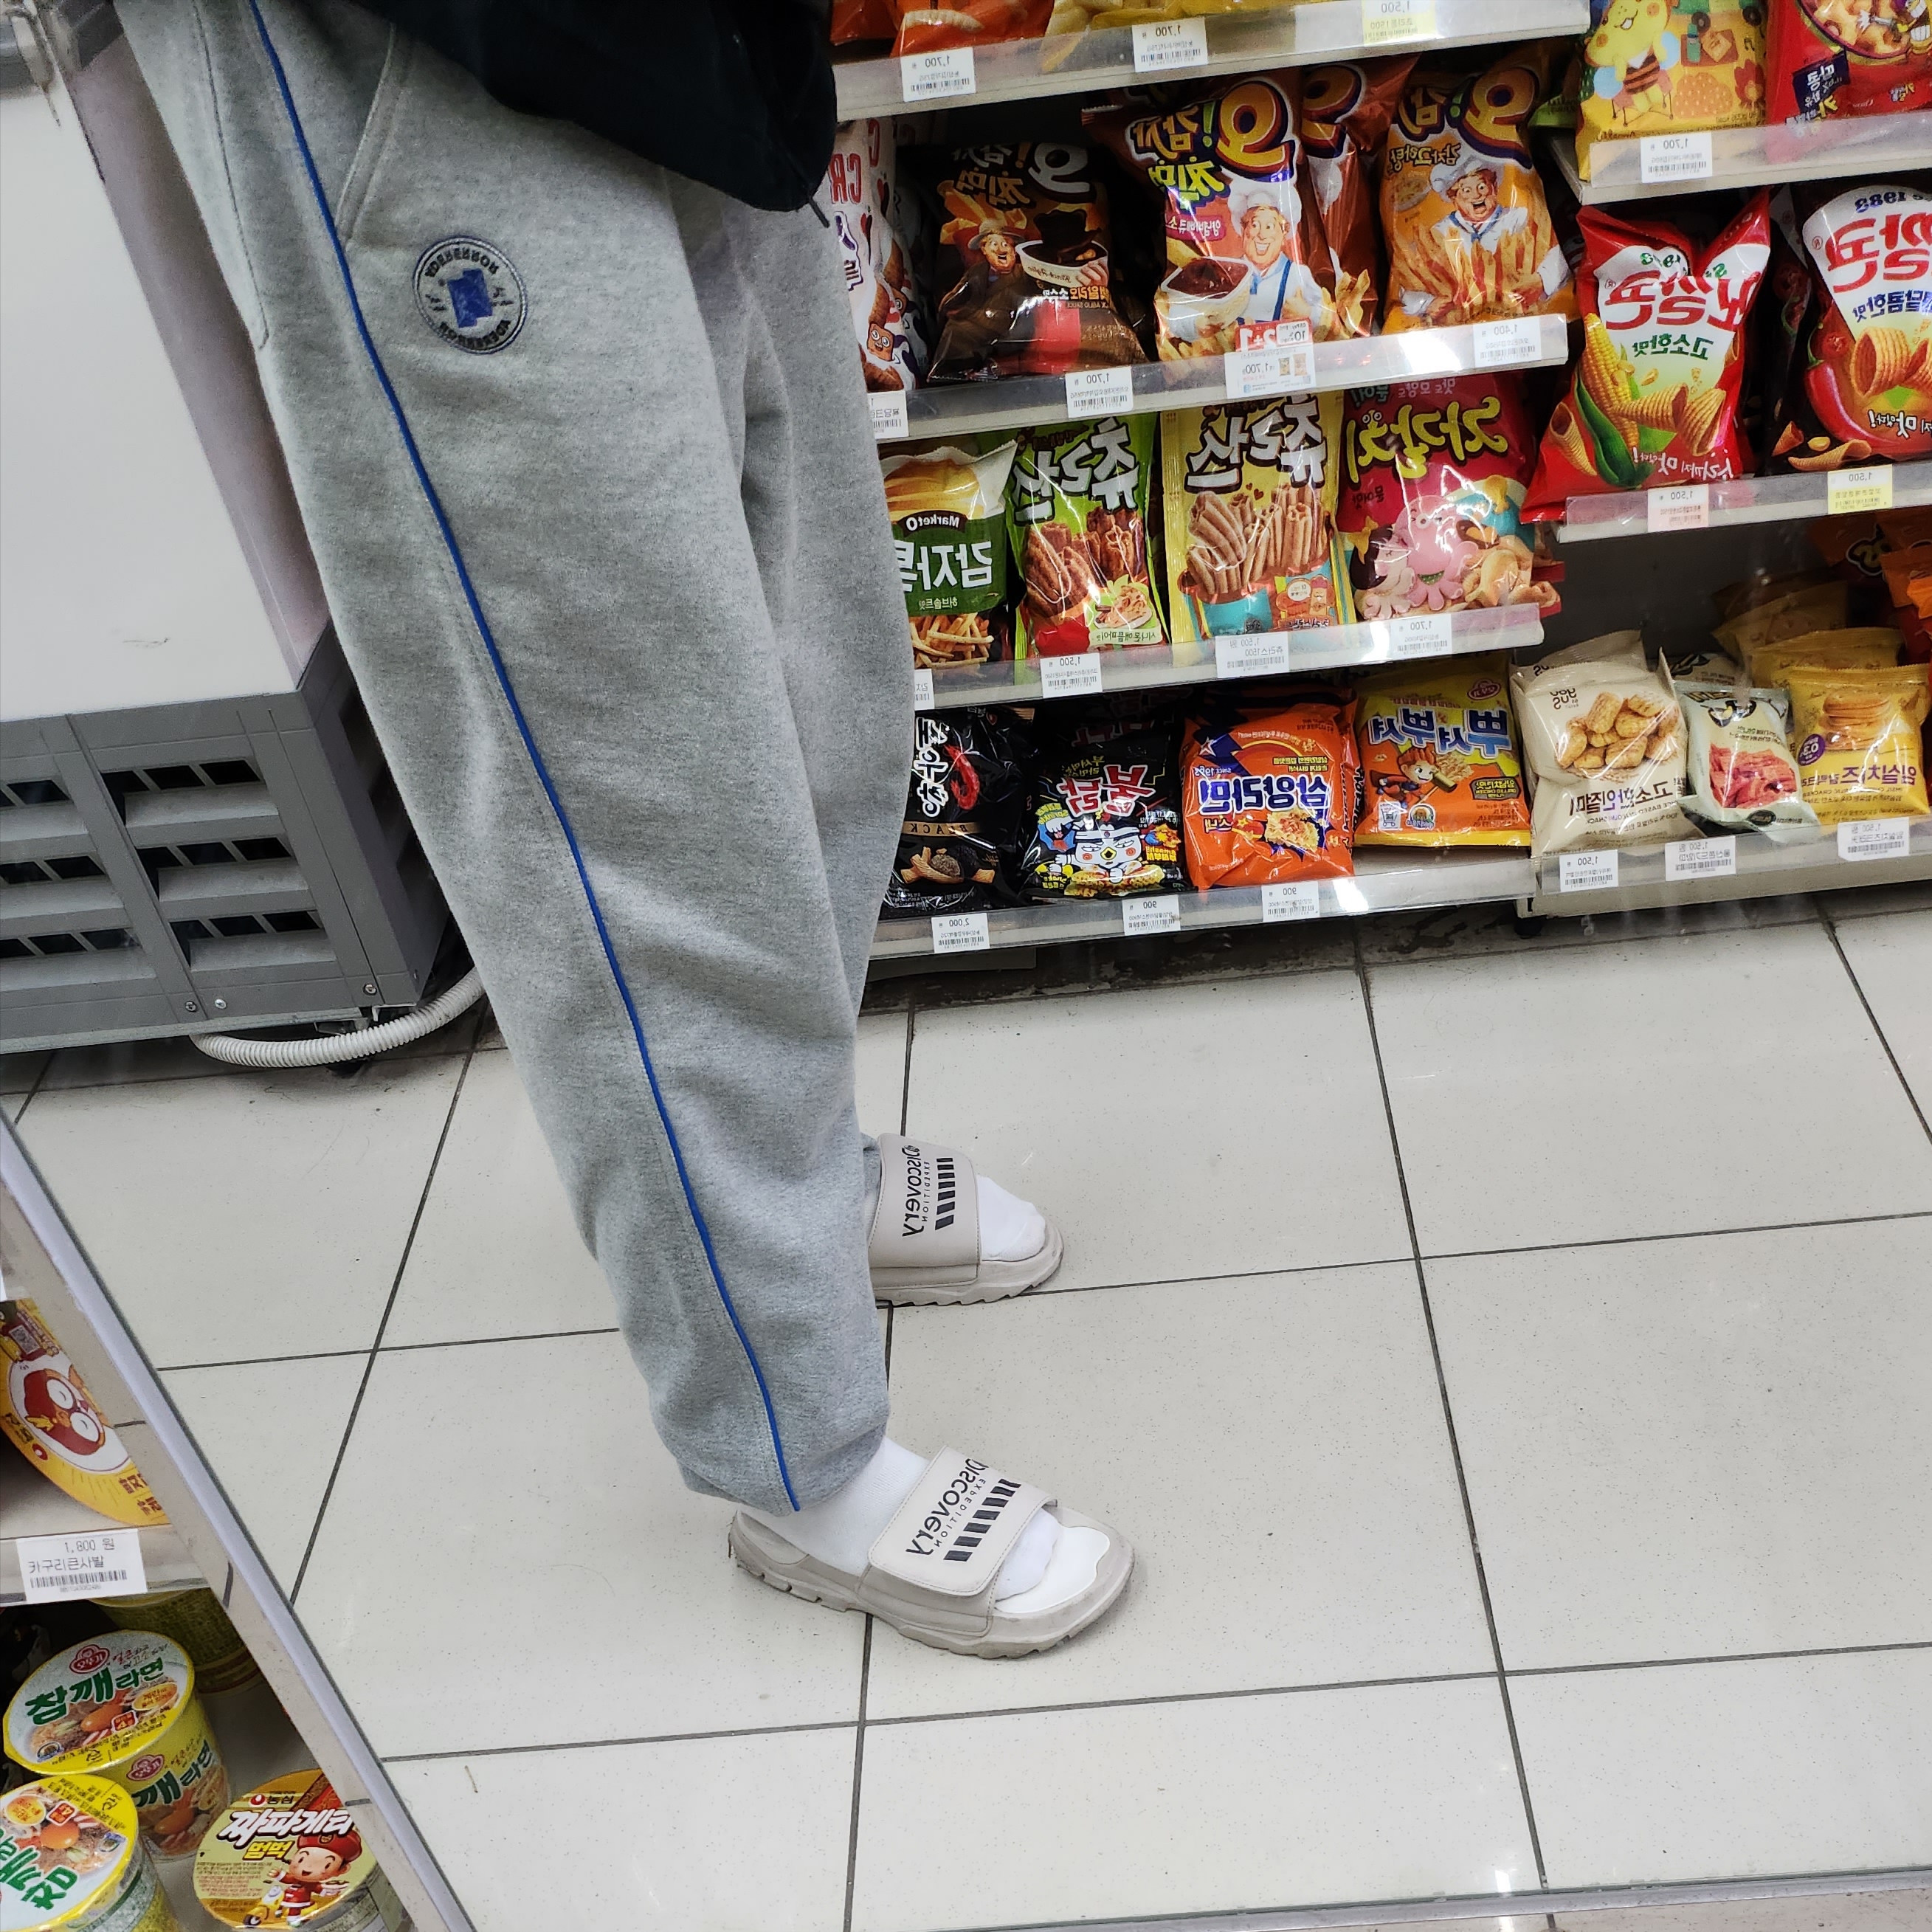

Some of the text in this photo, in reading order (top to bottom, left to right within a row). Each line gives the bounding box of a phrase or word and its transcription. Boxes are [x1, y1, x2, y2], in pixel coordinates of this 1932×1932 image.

[63, 1537, 115, 1553] 1,800 원
[28, 1555, 105, 1573] 카구리큰사발
[25, 1657, 164, 1725] 참깨라면
[131, 1739, 213, 1807] 깨라면
[267, 1795, 294, 1805] 농심
[217, 1808, 354, 1850] 짜파게티
[243, 1840, 295, 1860] 범벅
[0, 1828, 79, 1911] 참깨라
